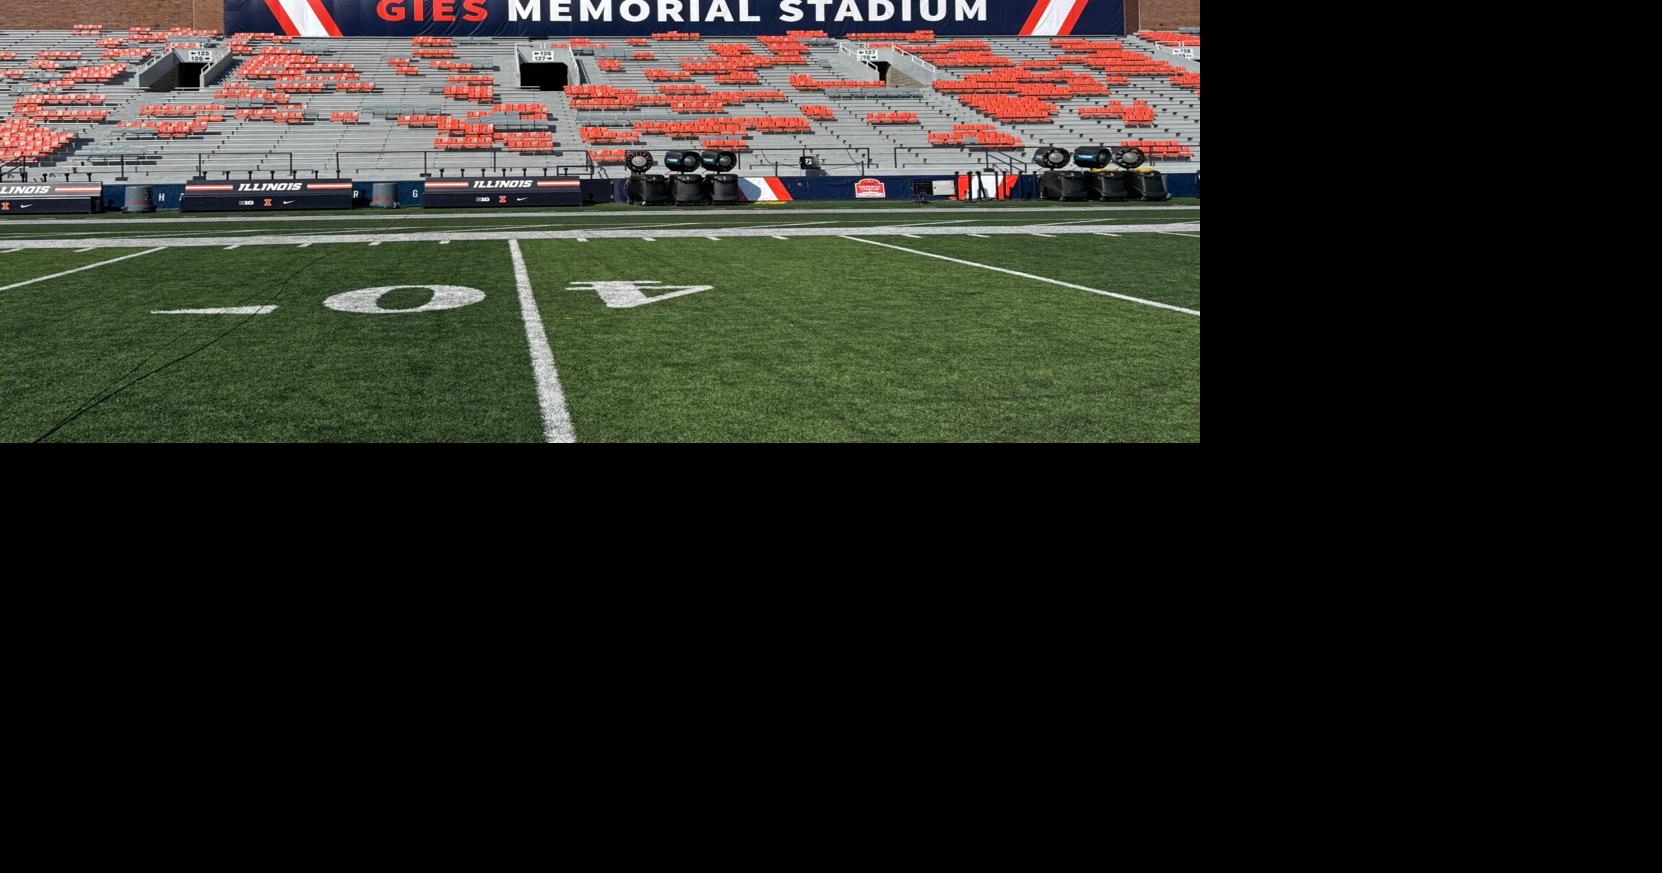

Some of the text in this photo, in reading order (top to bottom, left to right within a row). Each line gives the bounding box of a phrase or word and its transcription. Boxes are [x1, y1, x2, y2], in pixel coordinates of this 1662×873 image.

[376, 0, 987, 22] GIES MEMORIAL STADIUM
[237, 182, 303, 192] ILLINOIS
[473, 180, 534, 189] ILLINOIS
